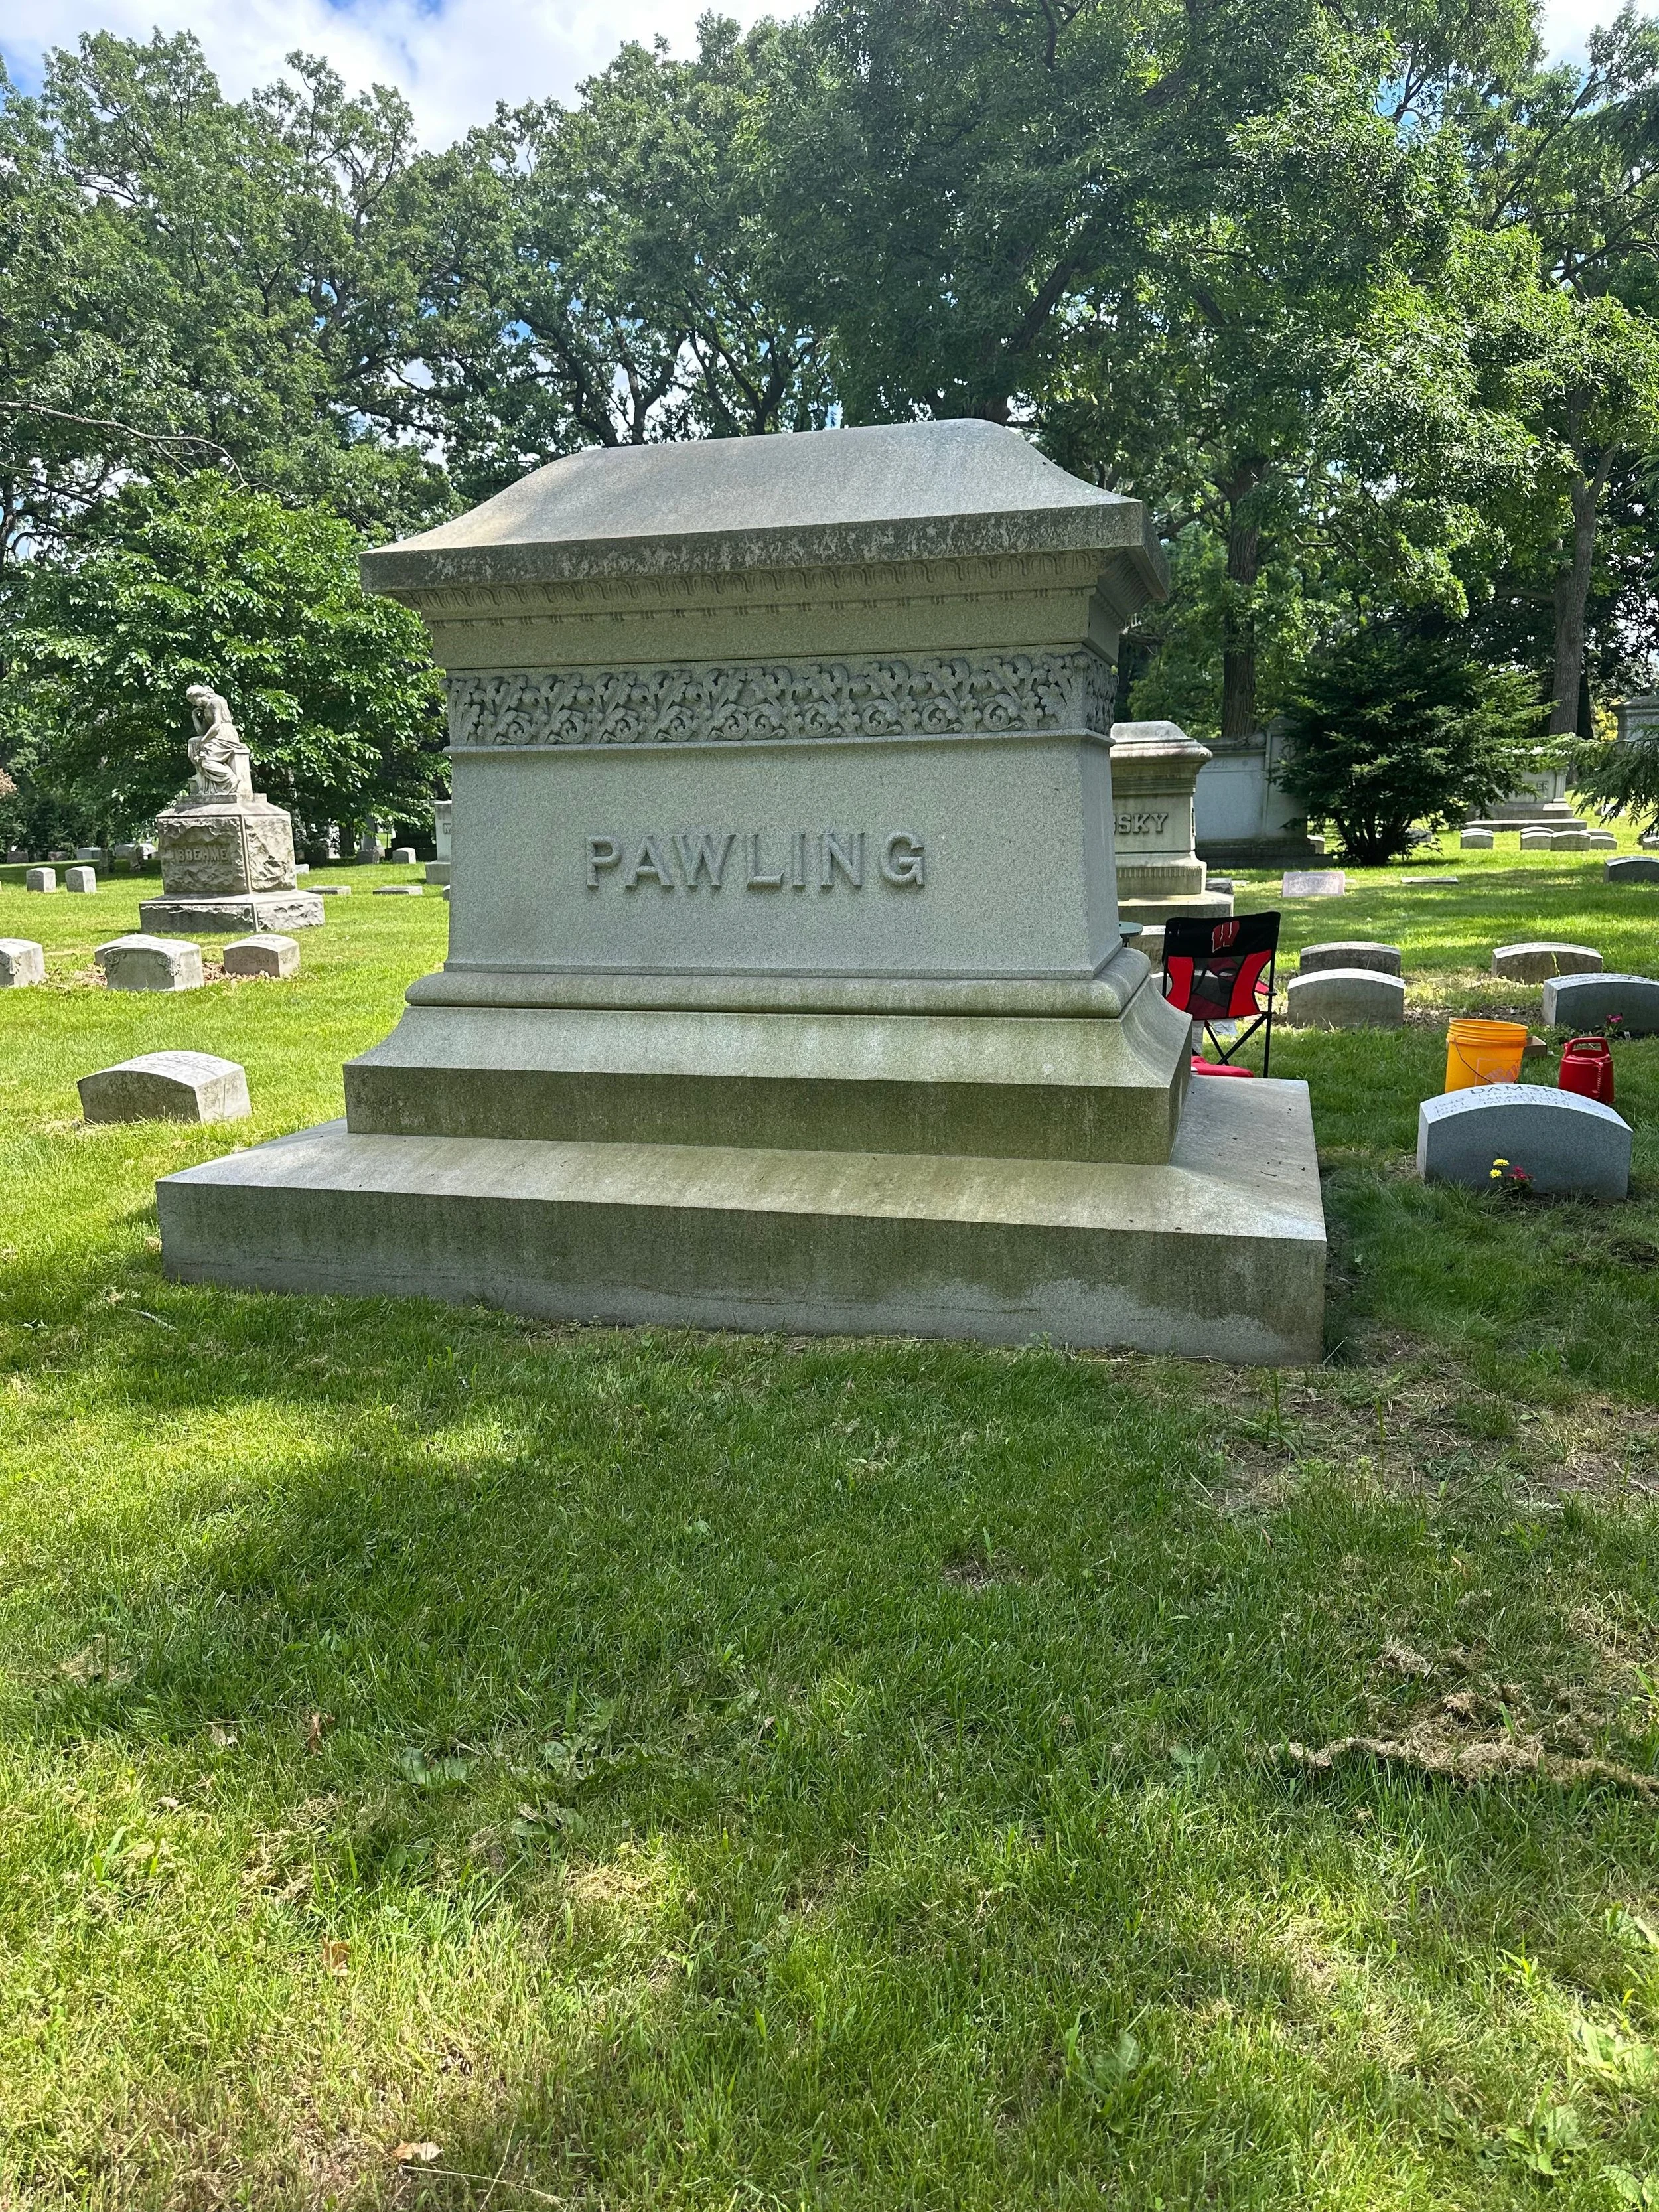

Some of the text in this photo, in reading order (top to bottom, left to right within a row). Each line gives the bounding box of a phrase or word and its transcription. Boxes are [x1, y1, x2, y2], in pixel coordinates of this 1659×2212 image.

[1112, 813, 1168, 834] SKY
[178, 849, 229, 861] BOEHME
[585, 831, 926, 889] PAWLING
[1211, 921, 1240, 954] W
